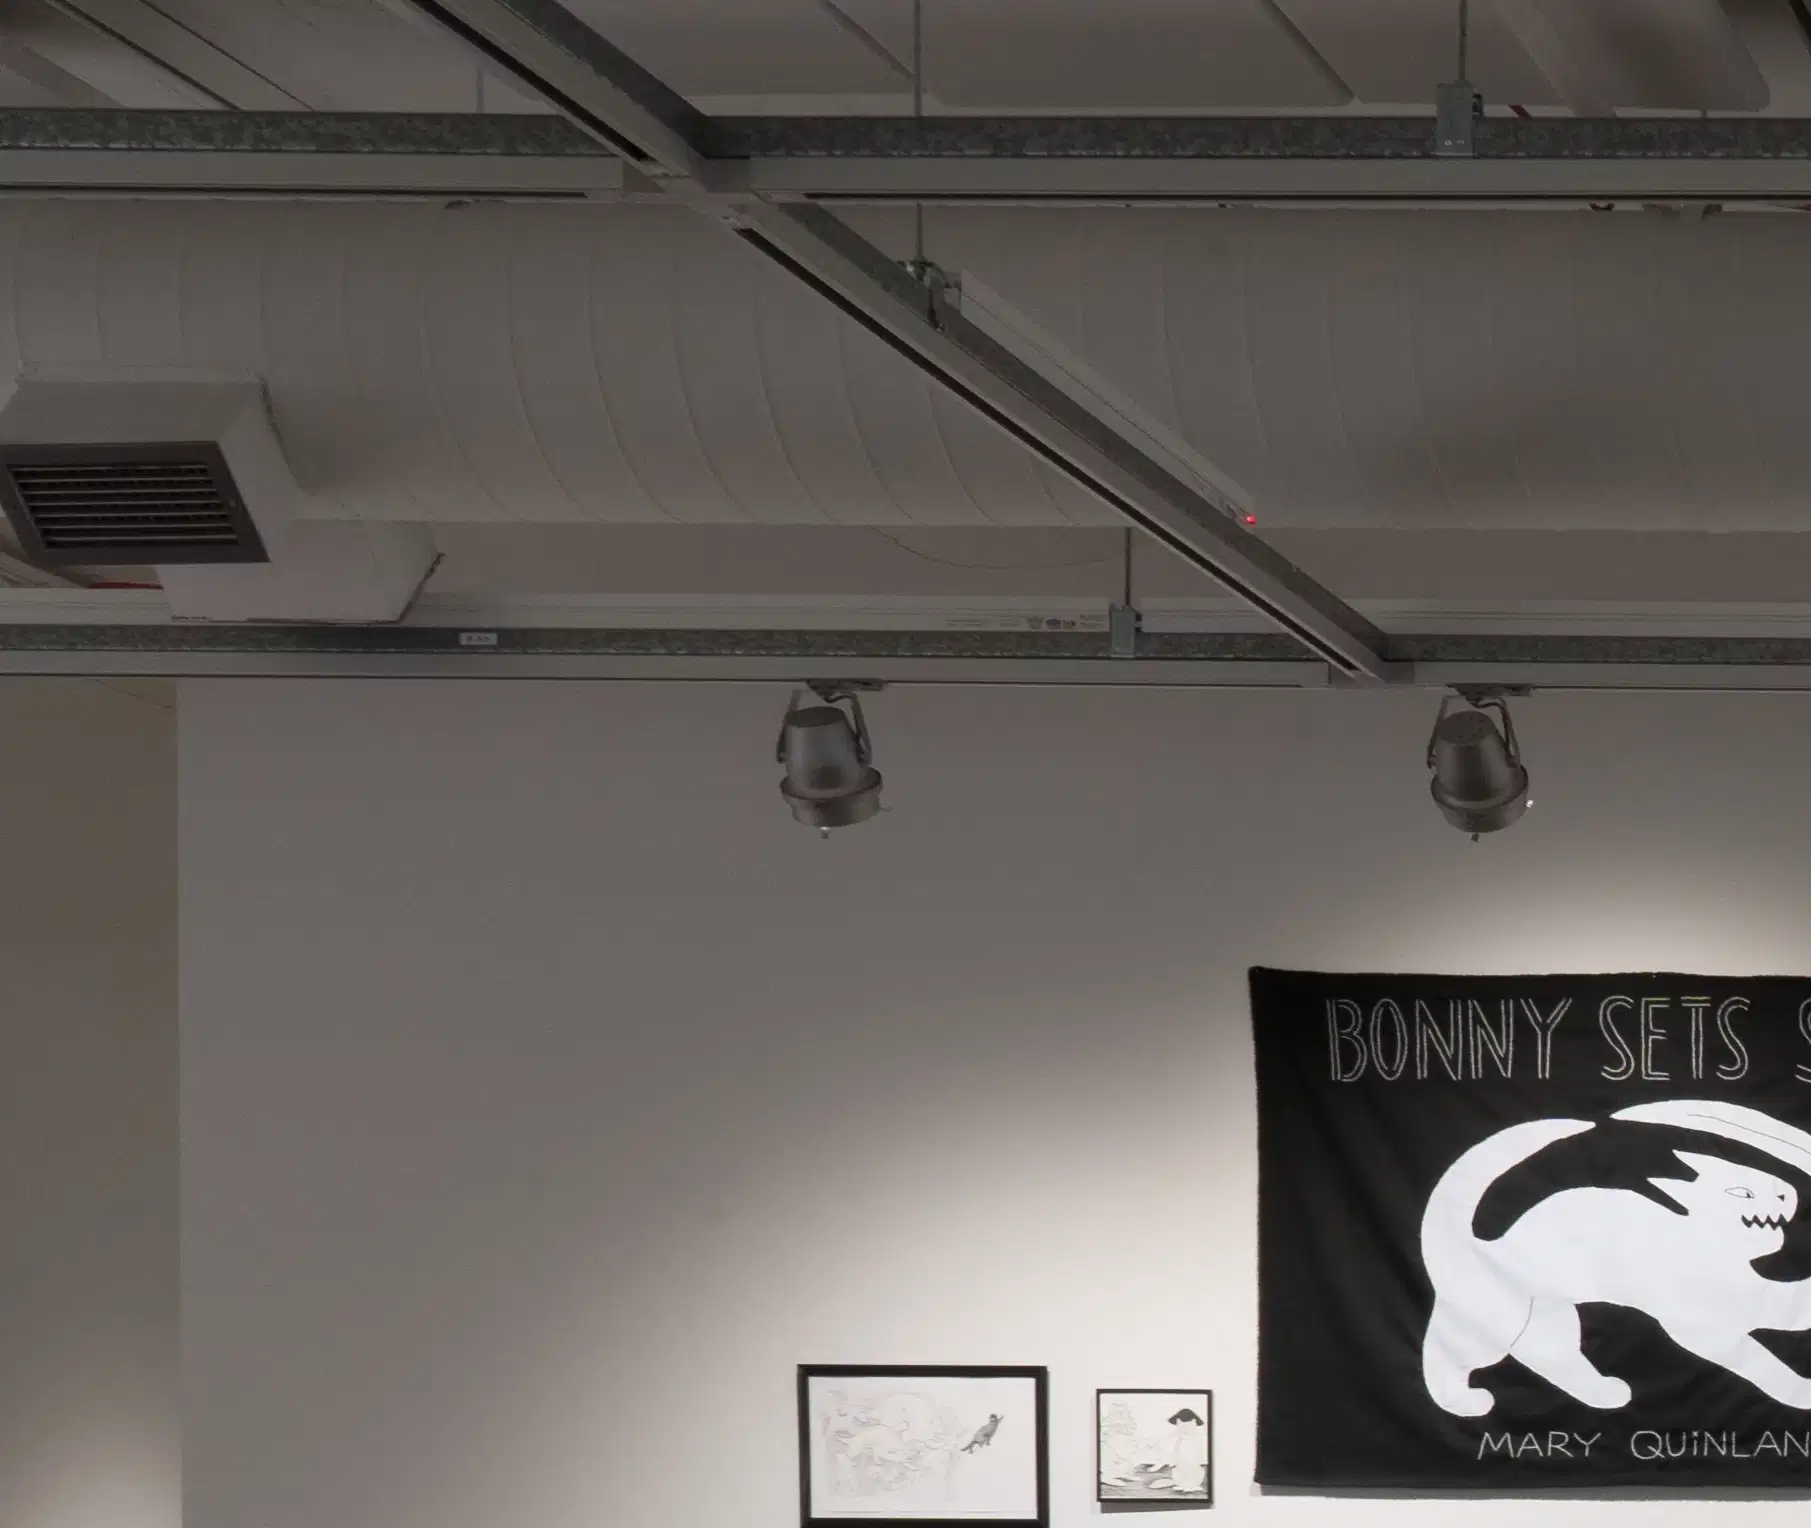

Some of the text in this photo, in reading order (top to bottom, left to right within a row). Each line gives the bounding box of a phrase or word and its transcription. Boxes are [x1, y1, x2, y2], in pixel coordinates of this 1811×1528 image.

[1326, 996, 1573, 1083] BONNY
[1598, 994, 1751, 1082] SETS
[1476, 1429, 1602, 1461] MARY
